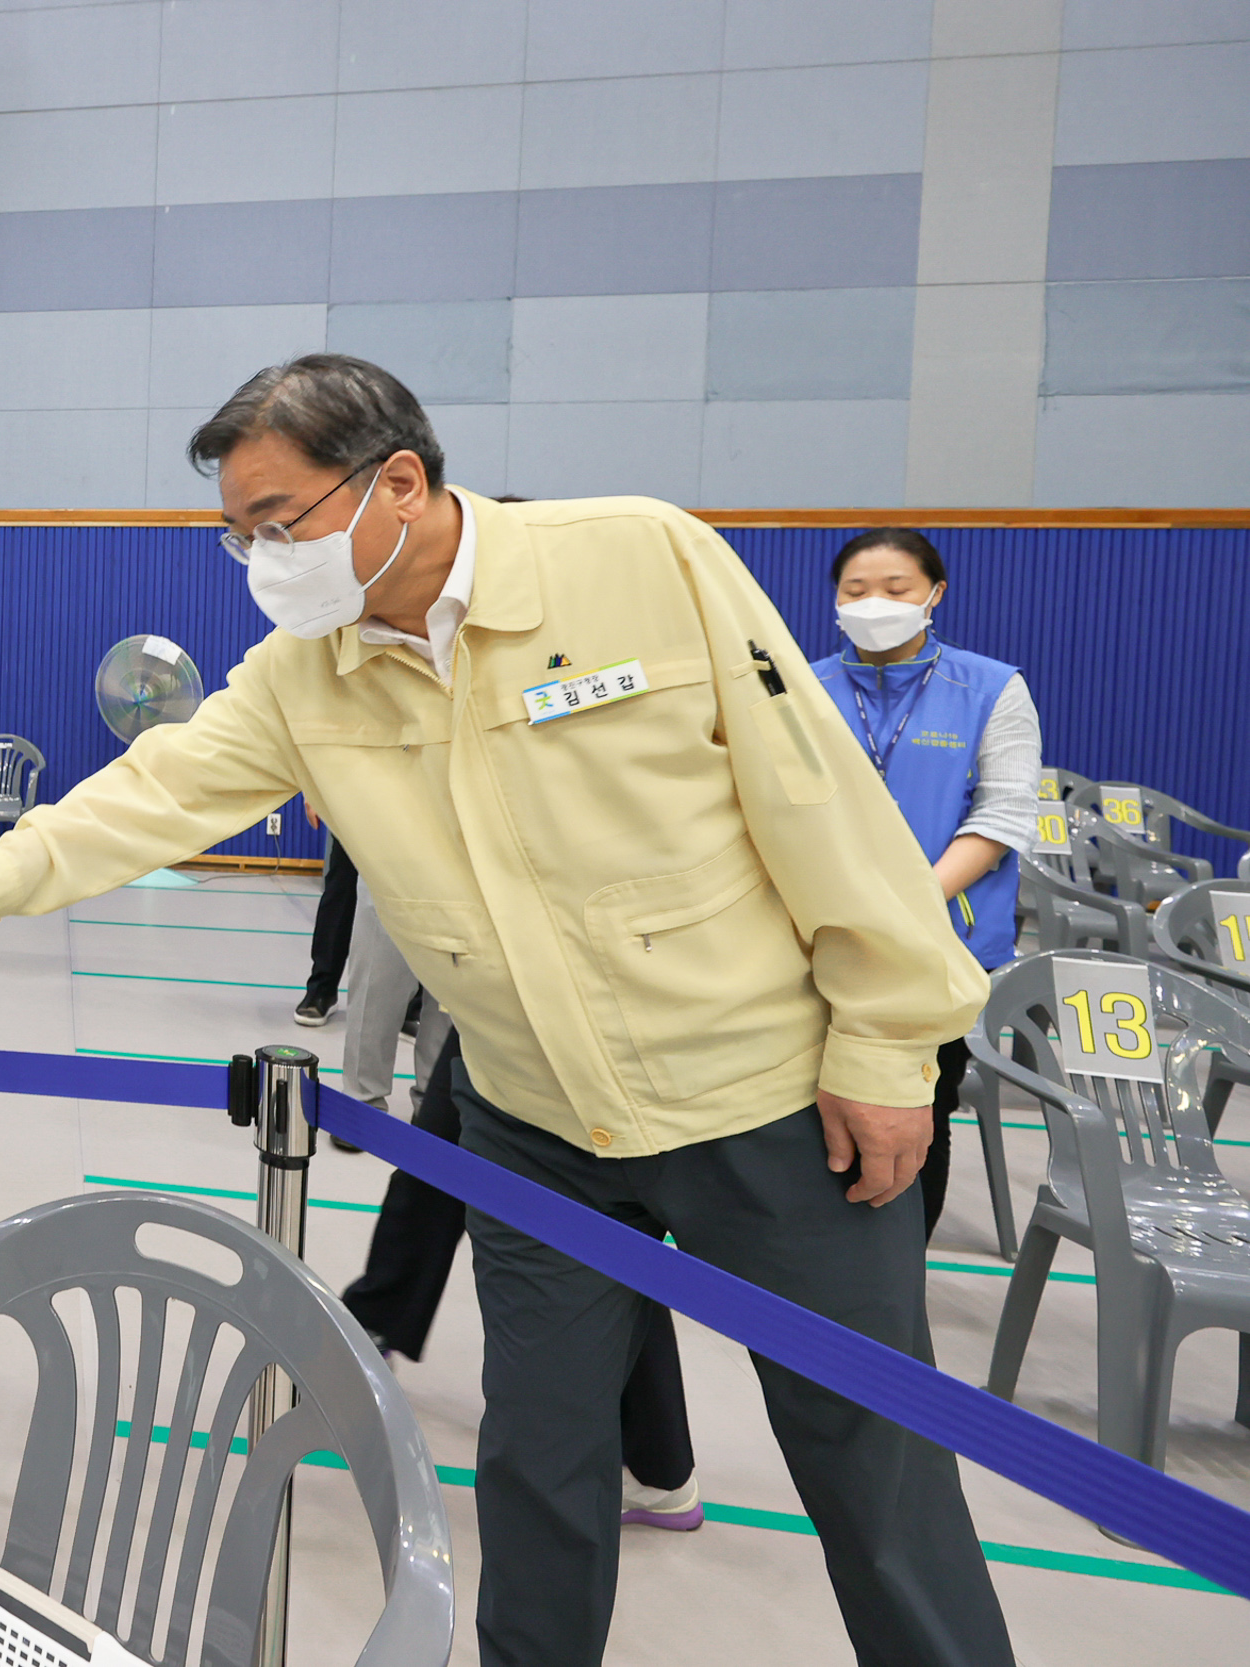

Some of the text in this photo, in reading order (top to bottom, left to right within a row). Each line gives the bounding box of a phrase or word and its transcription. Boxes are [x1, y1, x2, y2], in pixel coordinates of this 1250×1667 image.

[1037, 778, 1059, 800] 3
[1103, 798, 1142, 825] 36
[1219, 914, 1250, 962] 1
[1062, 989, 1152, 1060] 13
